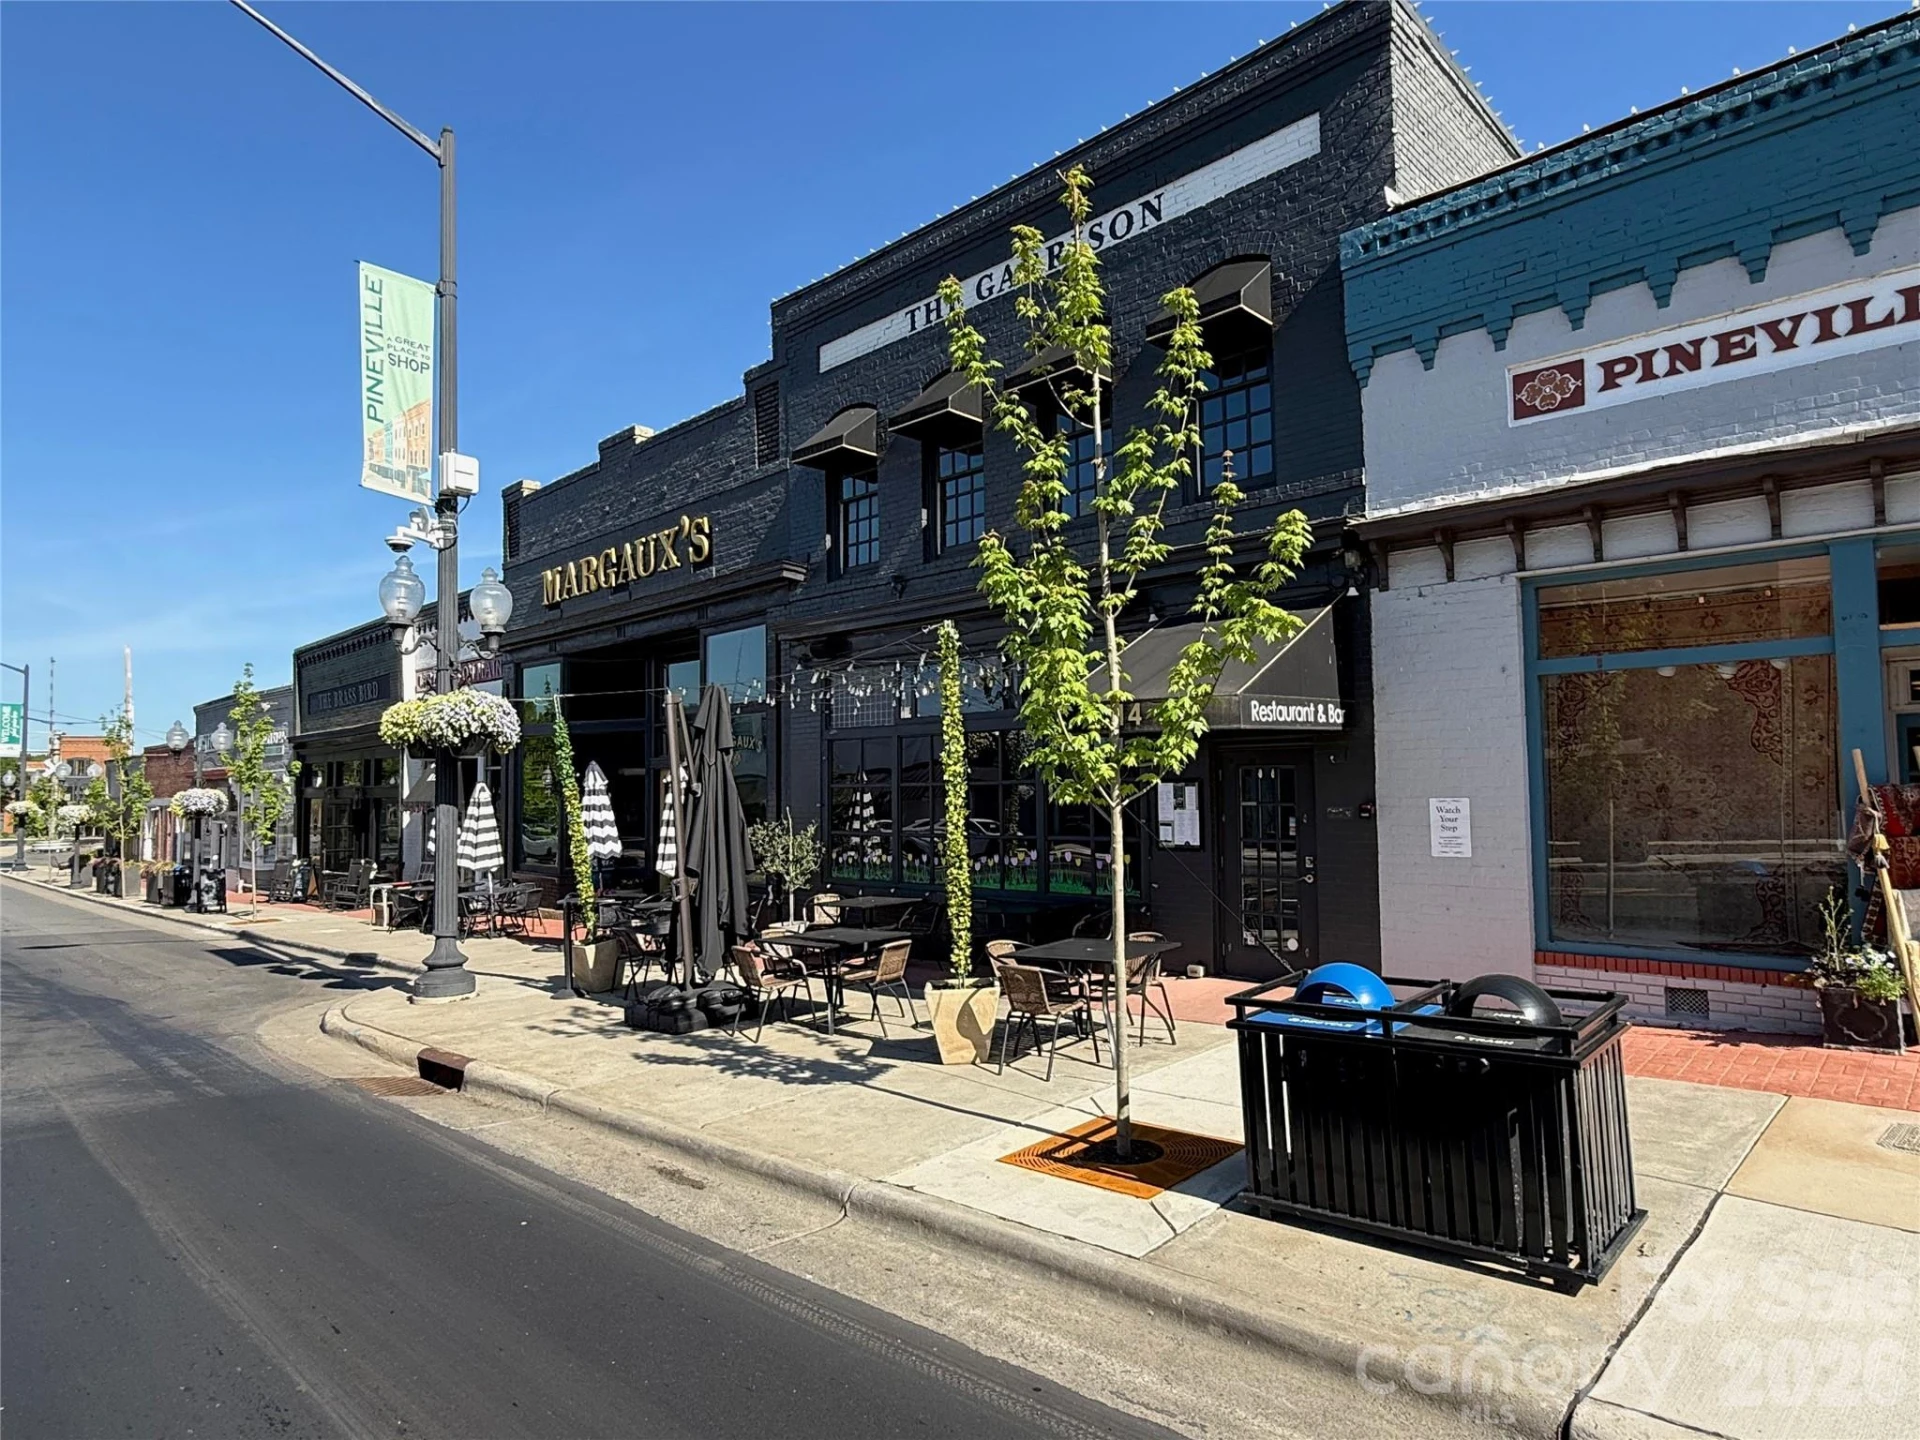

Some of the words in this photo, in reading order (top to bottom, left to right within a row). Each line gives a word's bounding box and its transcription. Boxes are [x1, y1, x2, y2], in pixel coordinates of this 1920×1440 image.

[905, 296, 962, 333] TH
[976, 193, 1165, 300] GARSON
[364, 274, 384, 423] PINEVILLE
[387, 343, 419, 357] PLACE
[394, 335, 431, 352] GREAT
[388, 352, 430, 374] SHOP
[541, 515, 710, 606] MARGAUX'S
[319, 692, 333, 709] THE
[333, 687, 358, 707] BRASS
[359, 681, 379, 702] BIRD
[1251, 700, 1315, 724] Restaurant
[1317, 703, 1327, 723] &
[1328, 704, 1345, 725] Bar
[1436, 805, 1461, 814] Watch
[1440, 815, 1458, 823] Your
